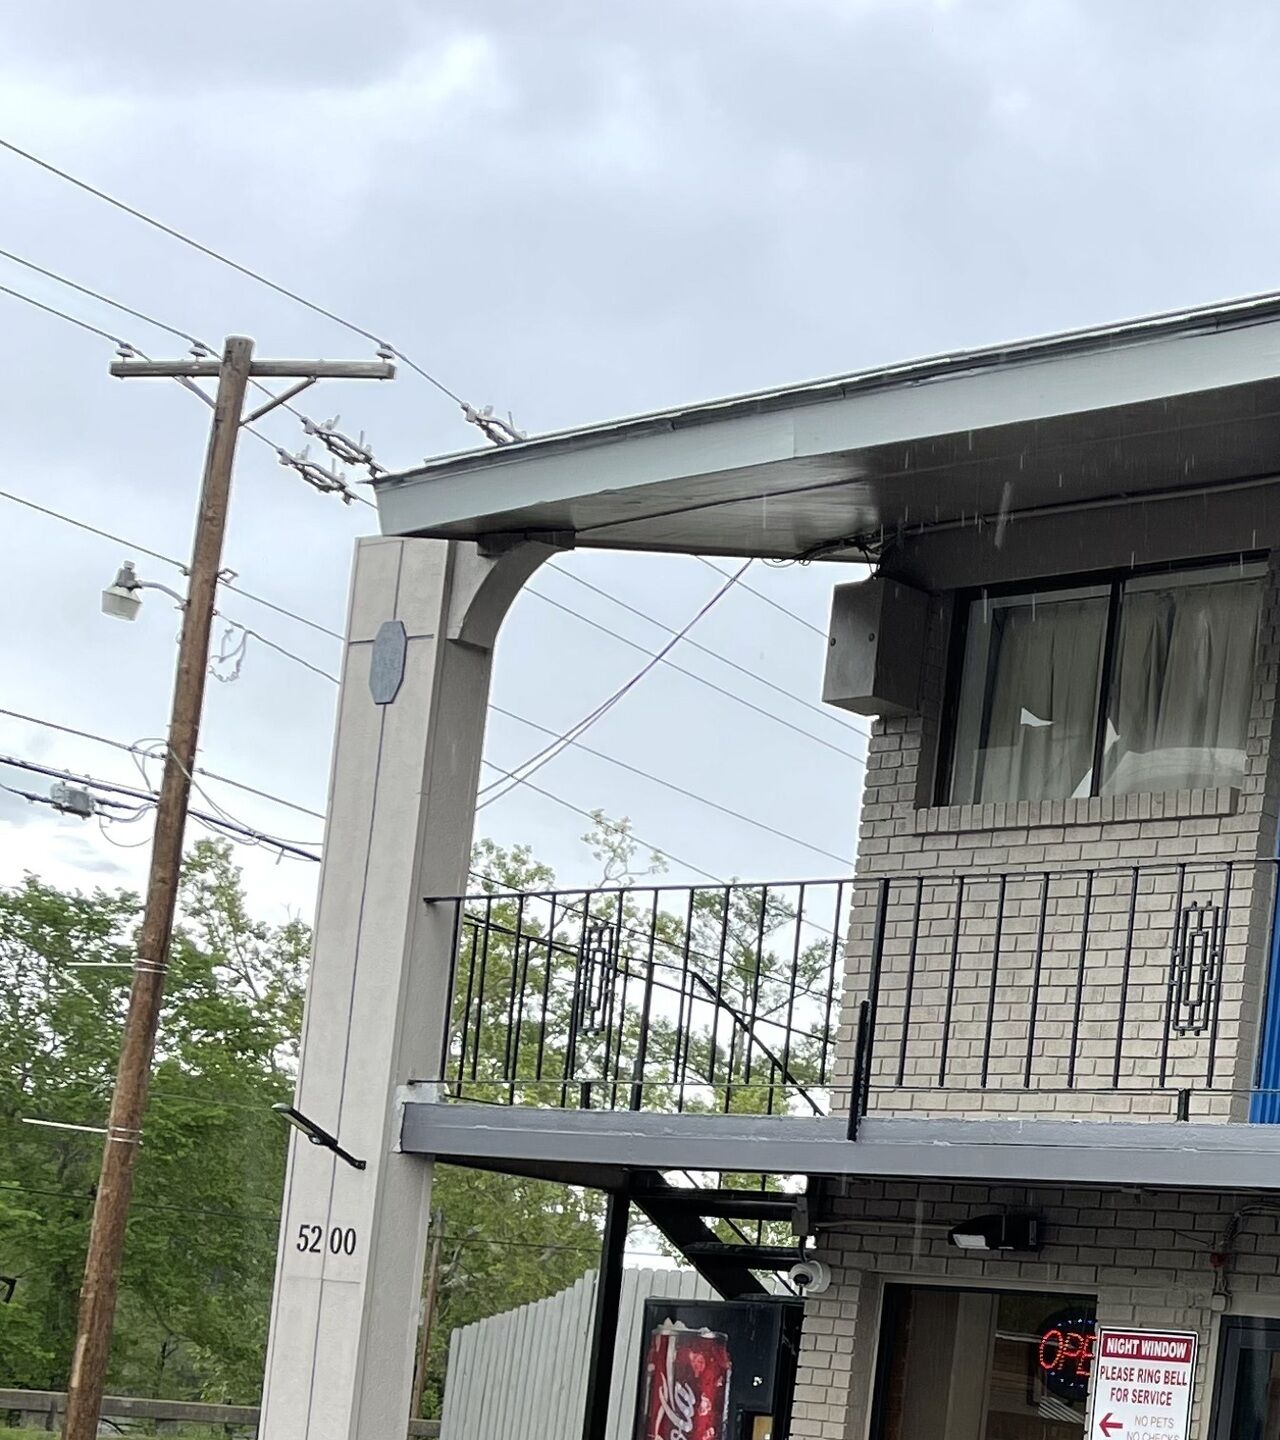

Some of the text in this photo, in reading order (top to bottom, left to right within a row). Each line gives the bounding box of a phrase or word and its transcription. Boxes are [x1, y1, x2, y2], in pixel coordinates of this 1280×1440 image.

[296, 1224, 357, 1256] 5200
[1039, 1329, 1098, 1376] OPE
[1106, 1337, 1187, 1359] NIGHT WINDOW
[1100, 1365, 1188, 1386] PLEASE RING BELL
[1110, 1387, 1173, 1406] FOR SERVICE
[1134, 1415, 1175, 1429] NO PETS
